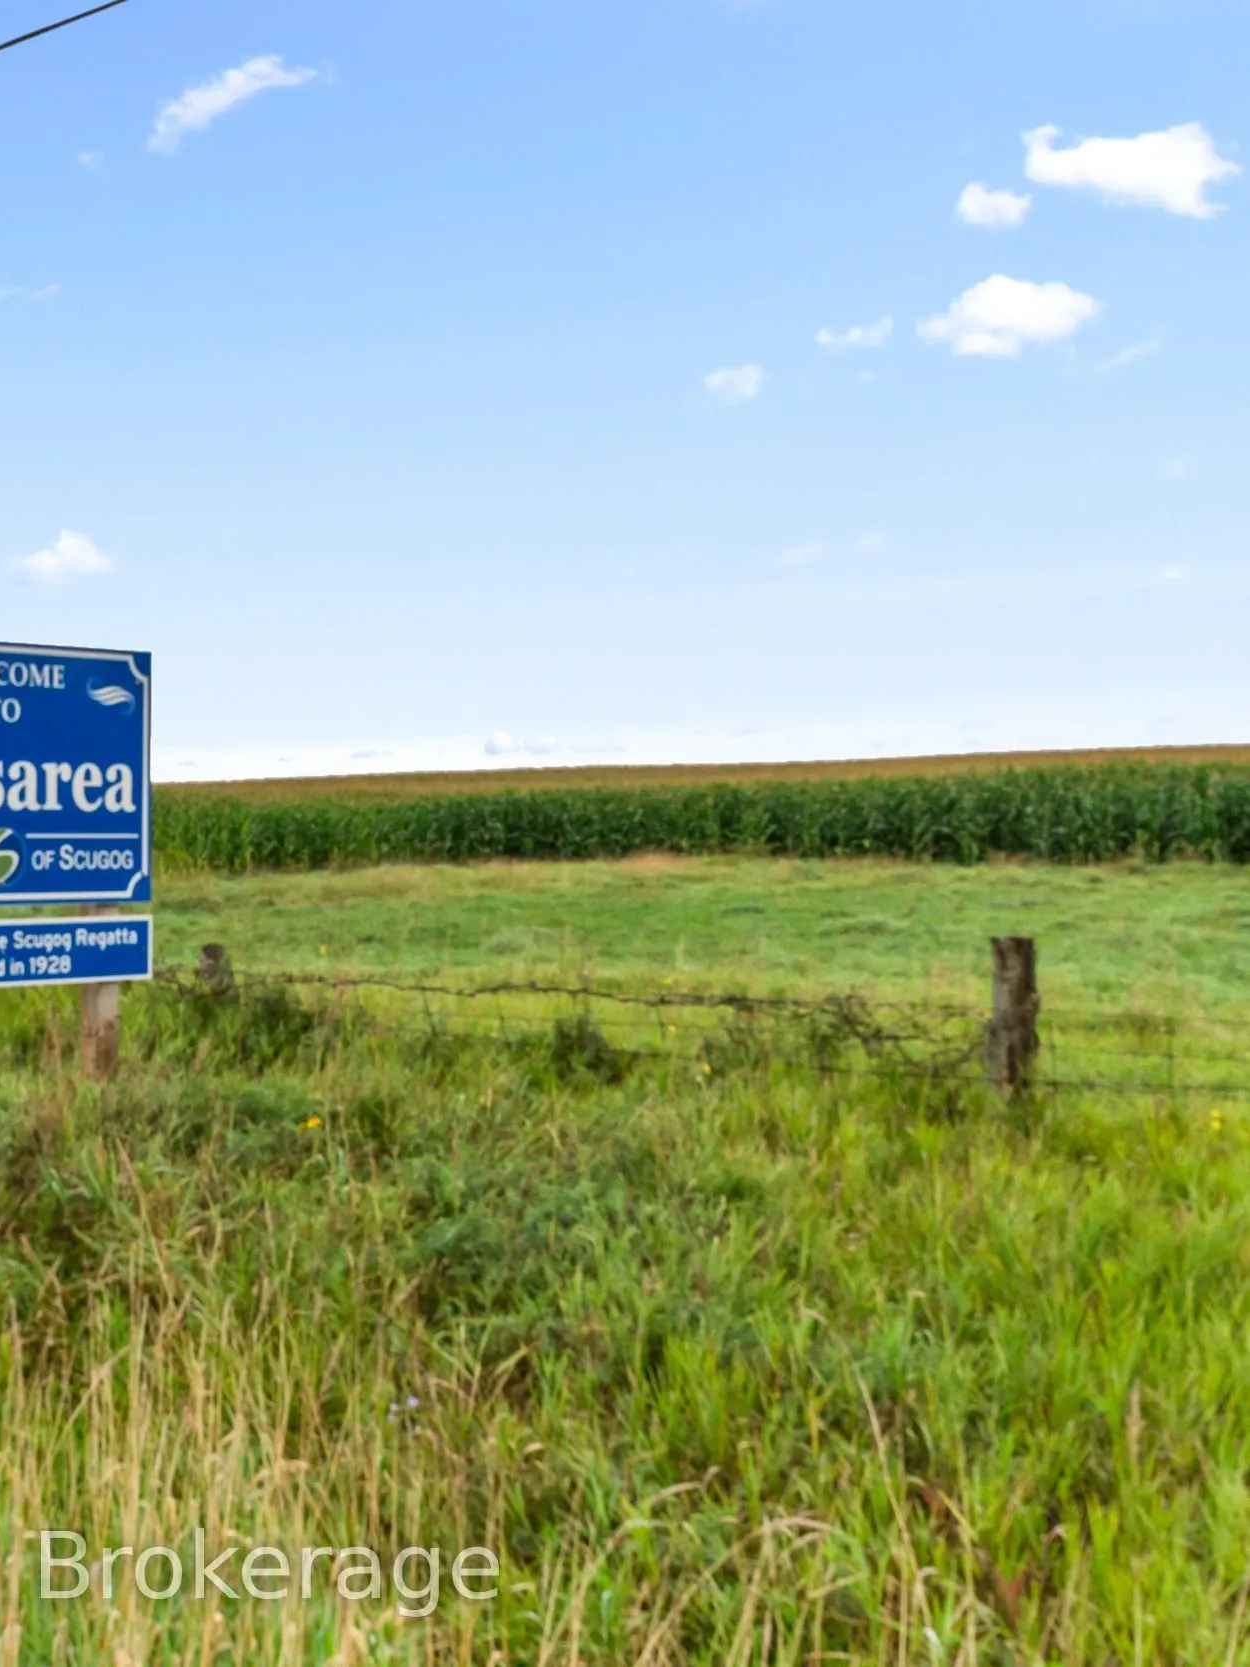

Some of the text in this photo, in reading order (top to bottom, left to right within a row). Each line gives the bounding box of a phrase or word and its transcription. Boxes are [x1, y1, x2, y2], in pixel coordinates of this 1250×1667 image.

[31, 849, 55, 871] OF
[59, 843, 134, 871] SCUGOG
[13, 929, 72, 953] Scugog
[75, 927, 138, 950] Regatta
[10, 956, 25, 976] in
[29, 954, 71, 975] 1928
